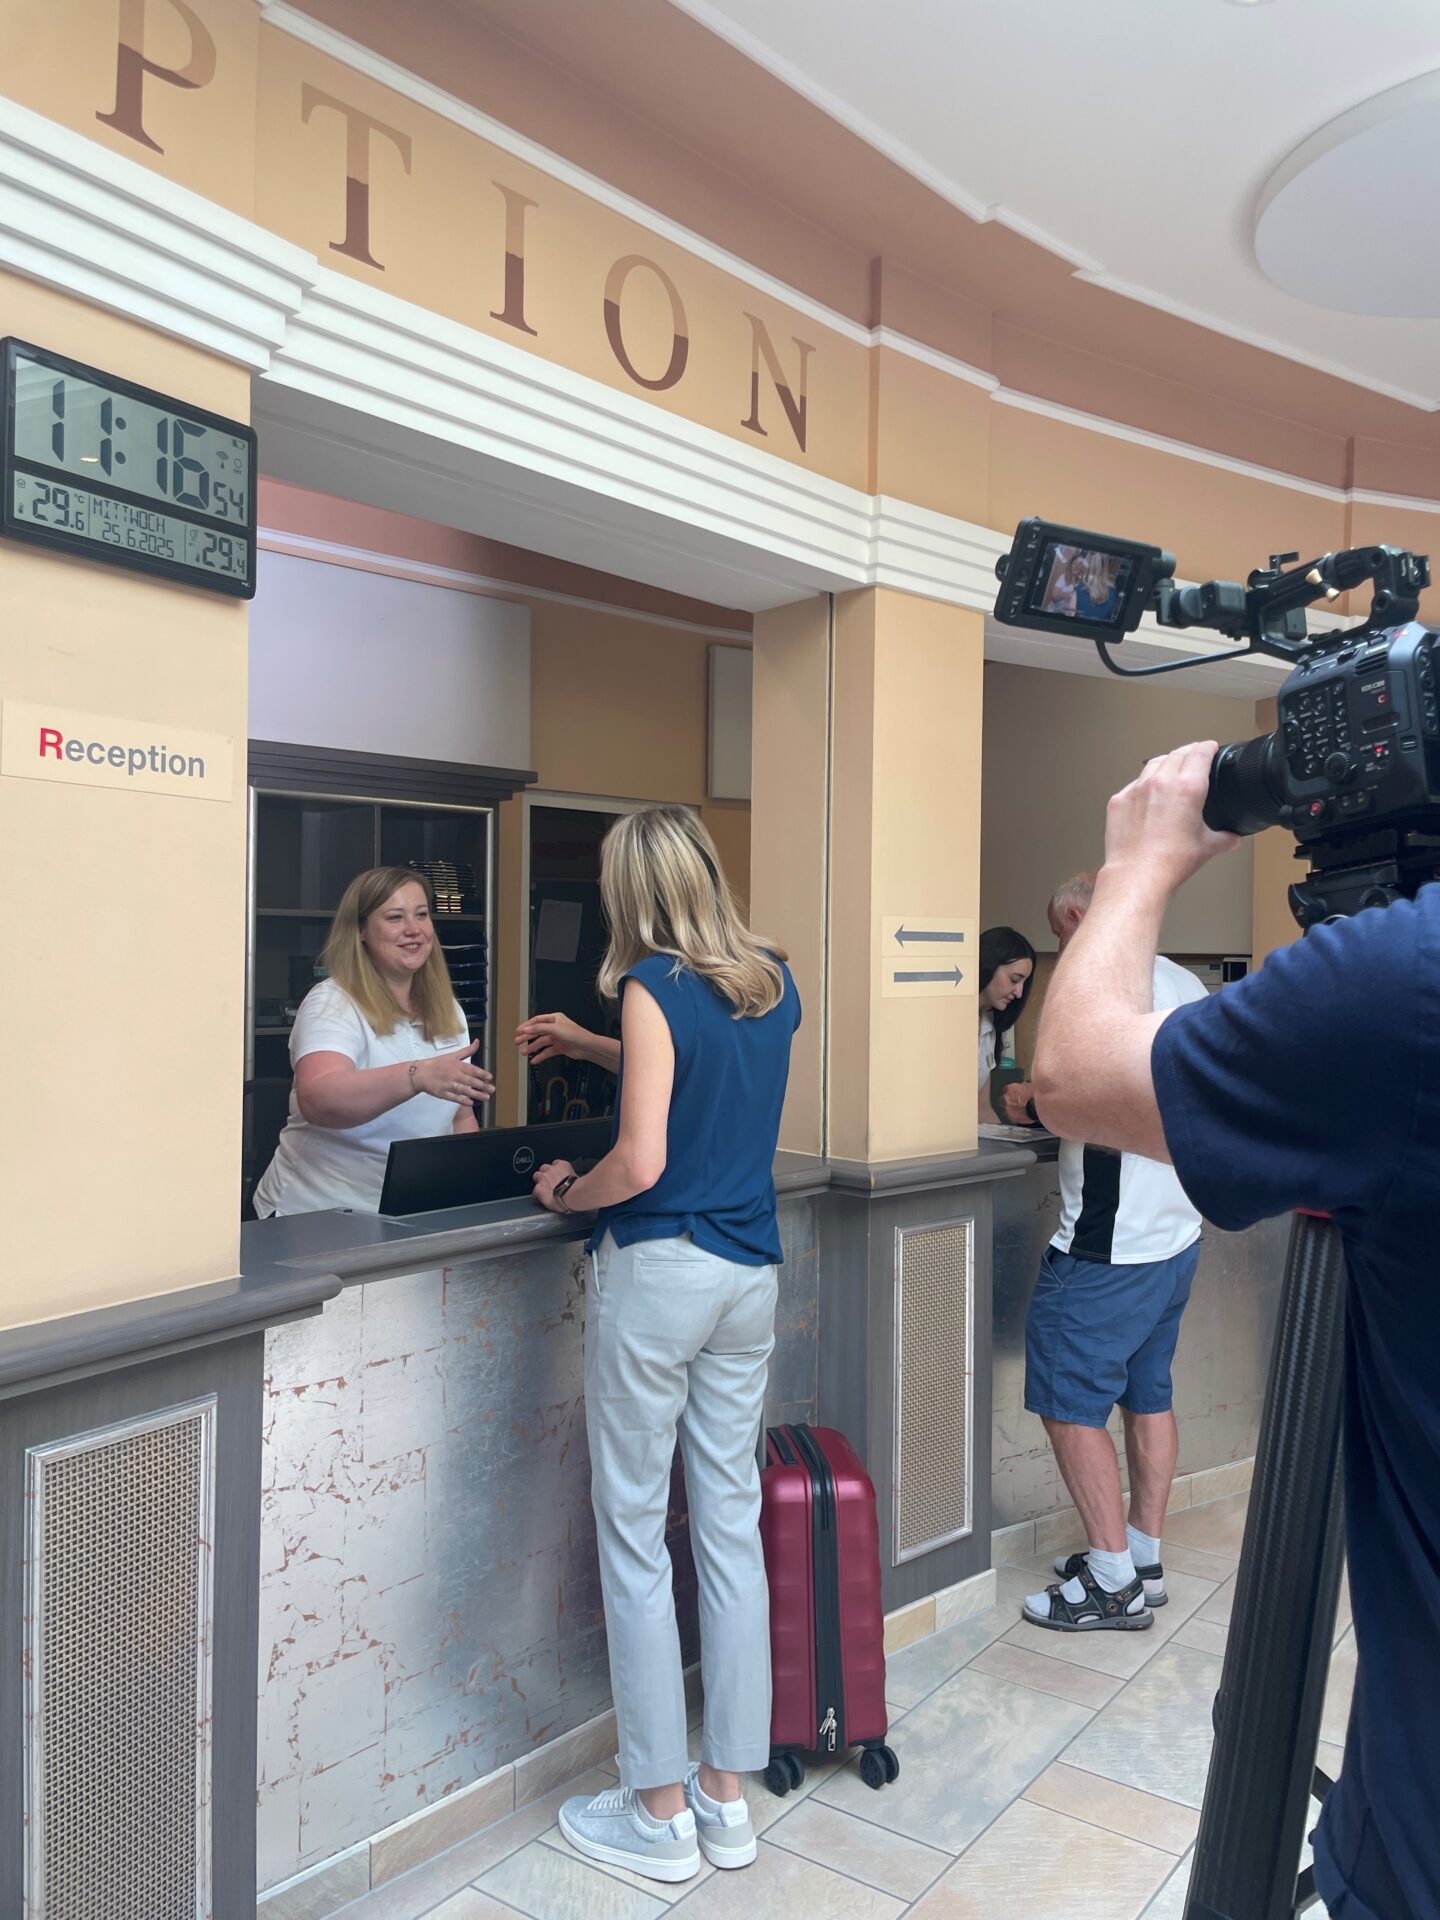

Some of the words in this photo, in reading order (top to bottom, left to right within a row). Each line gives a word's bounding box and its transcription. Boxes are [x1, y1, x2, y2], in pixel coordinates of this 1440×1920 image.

[52, 380, 210, 510] 11:16
[214, 481, 244, 521] 54
[33, 482, 84, 531] 29.6
[93, 495, 166, 534] MITTWOCH
[203, 532, 245, 574] 29.4
[39, 728, 205, 778] Reception
